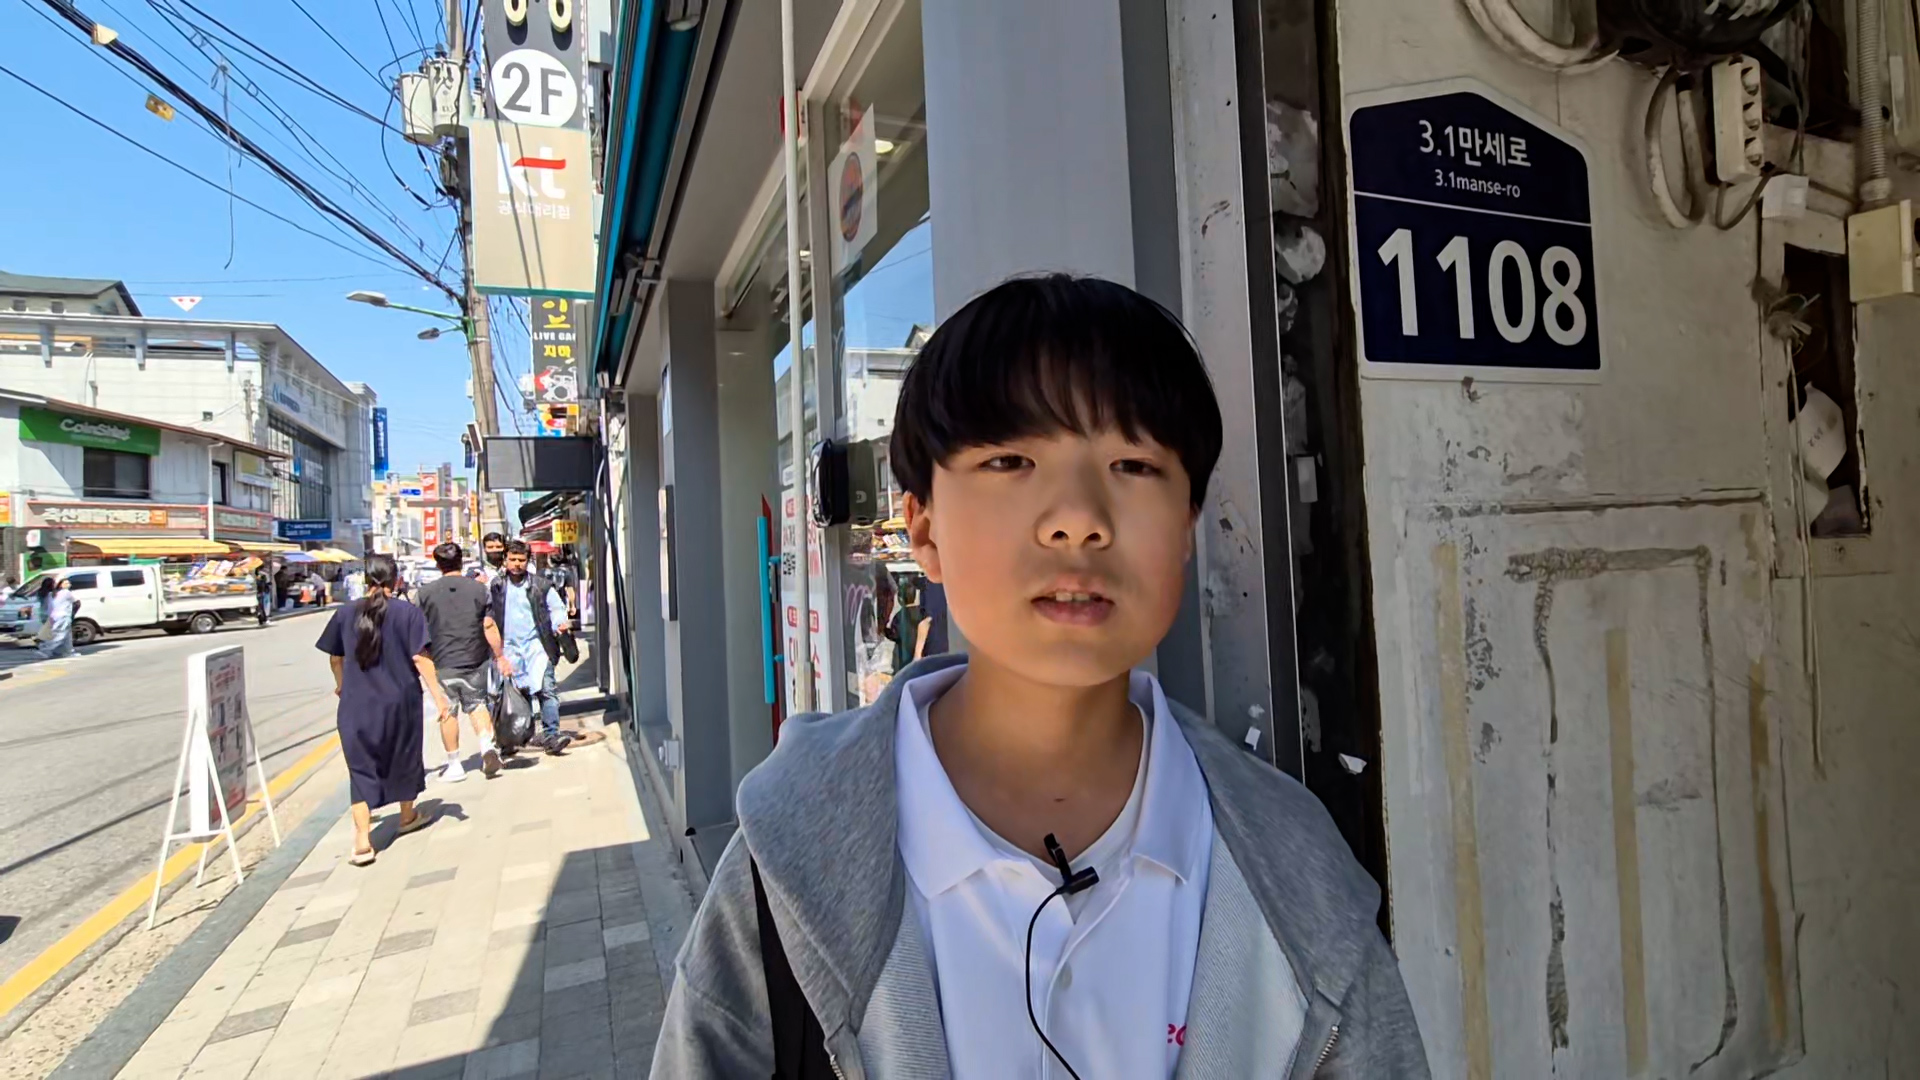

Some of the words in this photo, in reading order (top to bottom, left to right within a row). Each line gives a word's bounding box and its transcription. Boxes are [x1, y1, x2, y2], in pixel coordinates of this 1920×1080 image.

[501, 61, 566, 116] 2F
[1418, 119, 1532, 168] 3.1만세로
[497, 140, 567, 200] kt
[1434, 169, 1521, 199] 3.1manse-ro
[497, 199, 571, 220] 공식대리점
[1377, 227, 1587, 347] 1108
[533, 331, 556, 341] LIVE
[555, 521, 578, 535] 피자
